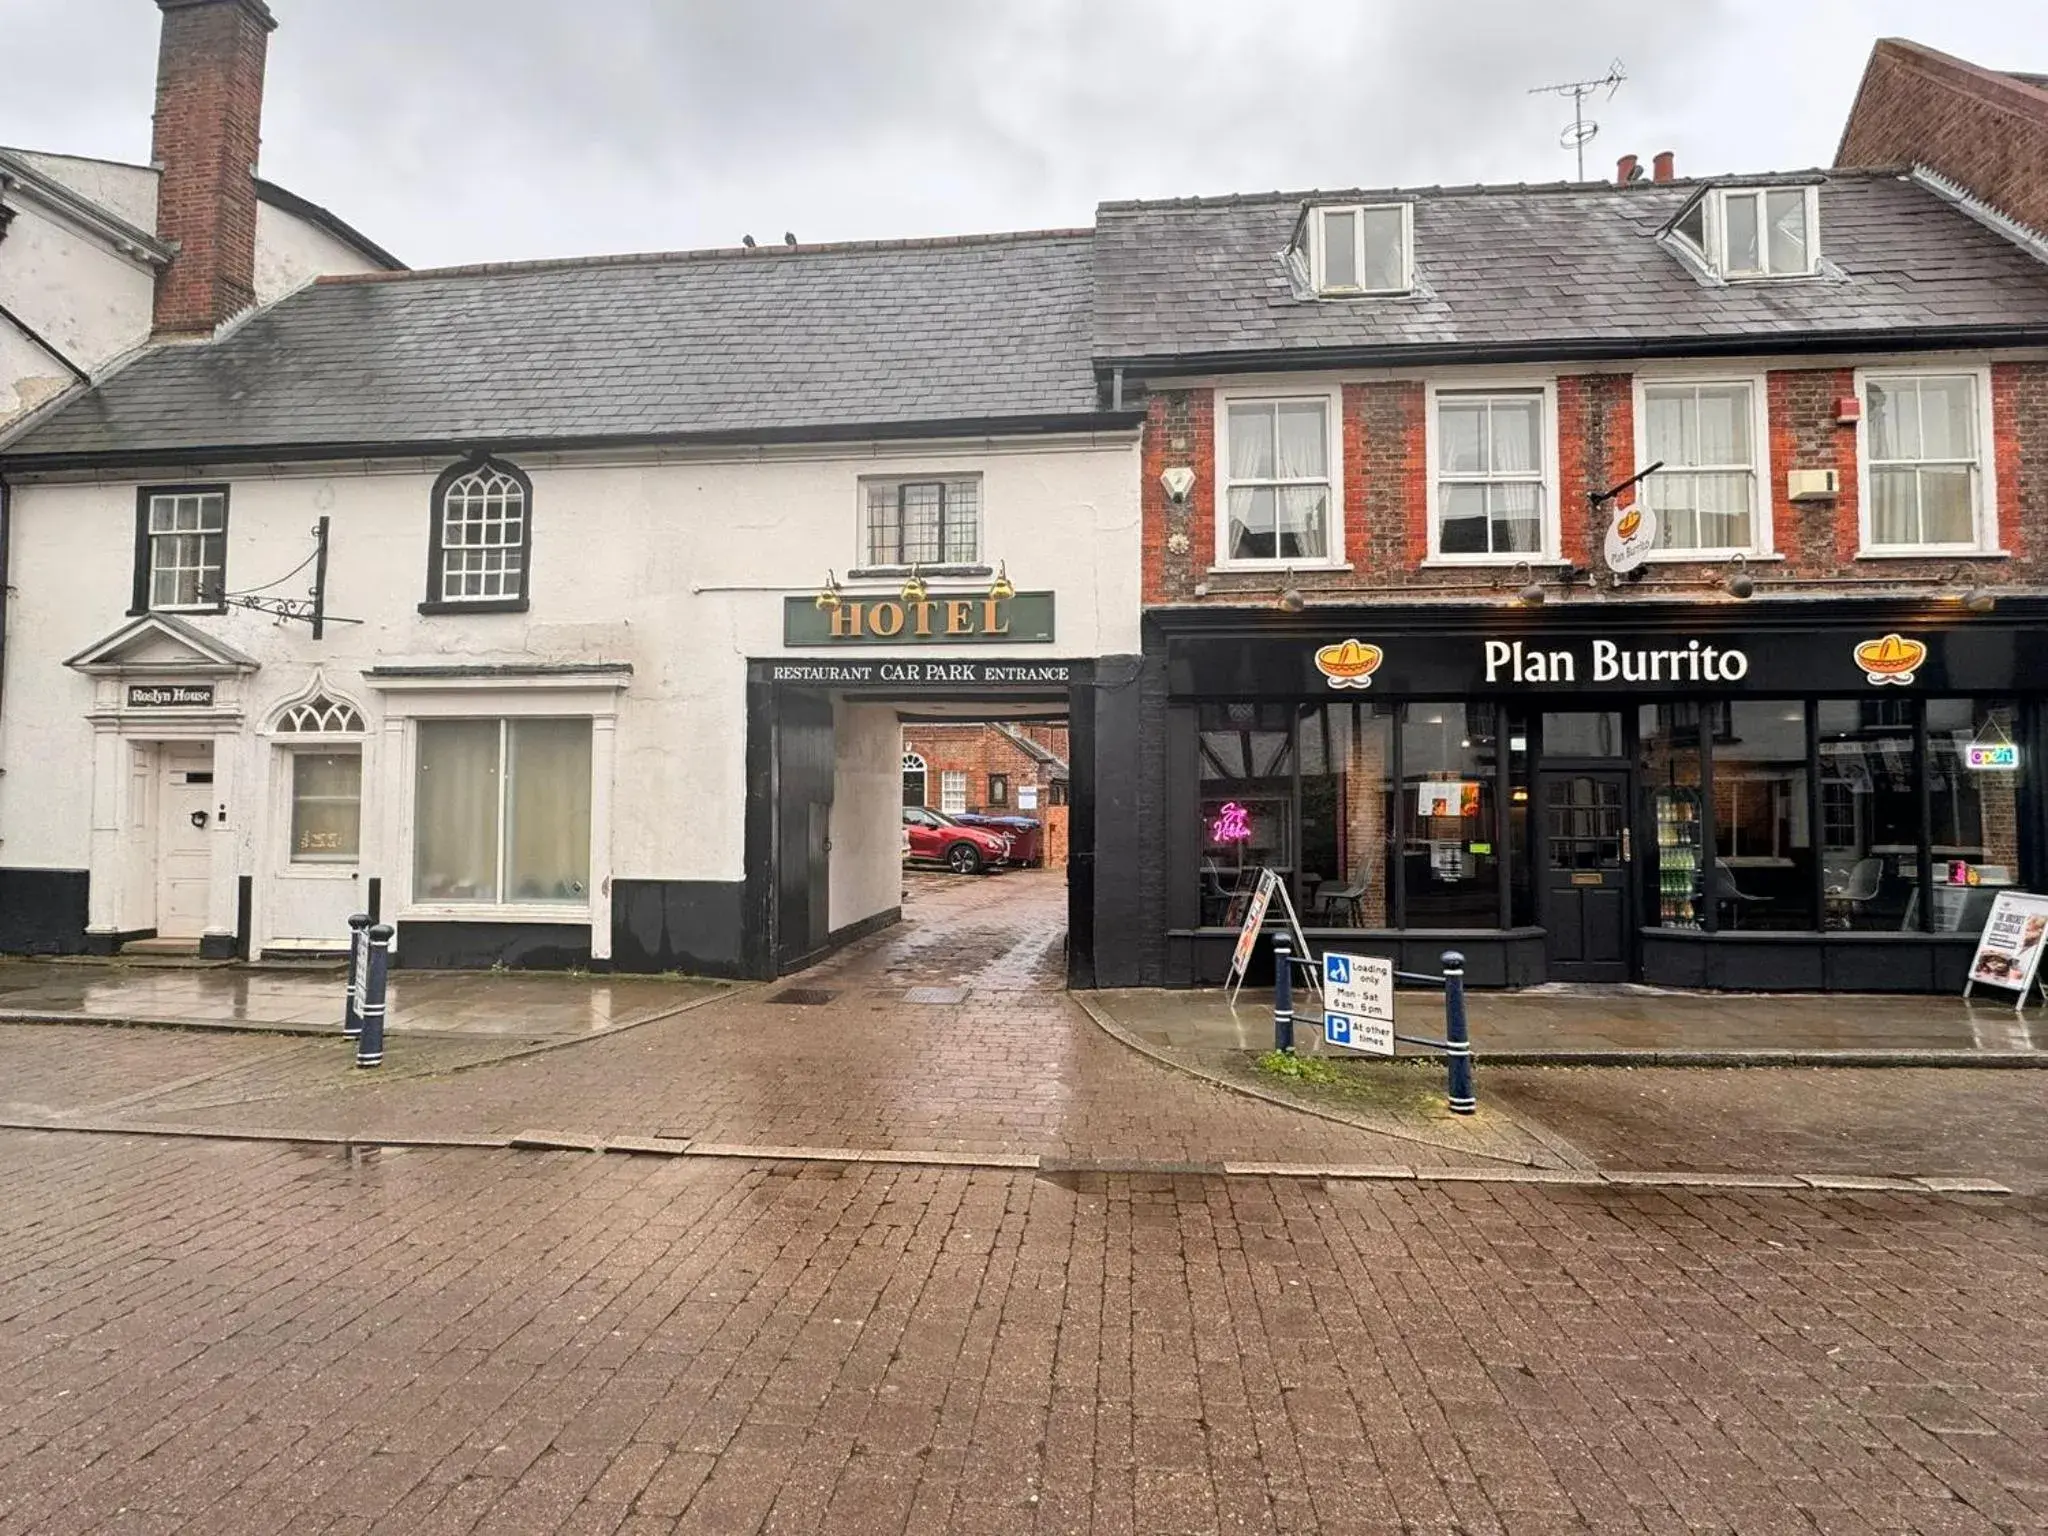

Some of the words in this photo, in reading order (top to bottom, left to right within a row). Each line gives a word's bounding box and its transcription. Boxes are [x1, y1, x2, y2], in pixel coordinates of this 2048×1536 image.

[828, 598, 1010, 637] HOTEL
[1485, 640, 1575, 682] Plan
[1592, 639, 1748, 681] Burrito
[774, 667, 872, 680] RESTAURANT
[880, 664, 920, 680] CAR
[926, 664, 976, 680] PARK
[985, 667, 1069, 680] ENTRANCE
[132, 688, 171, 704] Roslyn
[171, 687, 210, 703] House
[1352, 963, 1388, 976] Loading
[1360, 975, 1379, 985] only
[1337, 987, 1356, 998] Mon
[1362, 991, 1378, 1001] Sat
[1352, 1022, 1363, 1032] At
[1365, 1025, 1390, 1036] other
[1359, 1034, 1384, 1046] times
